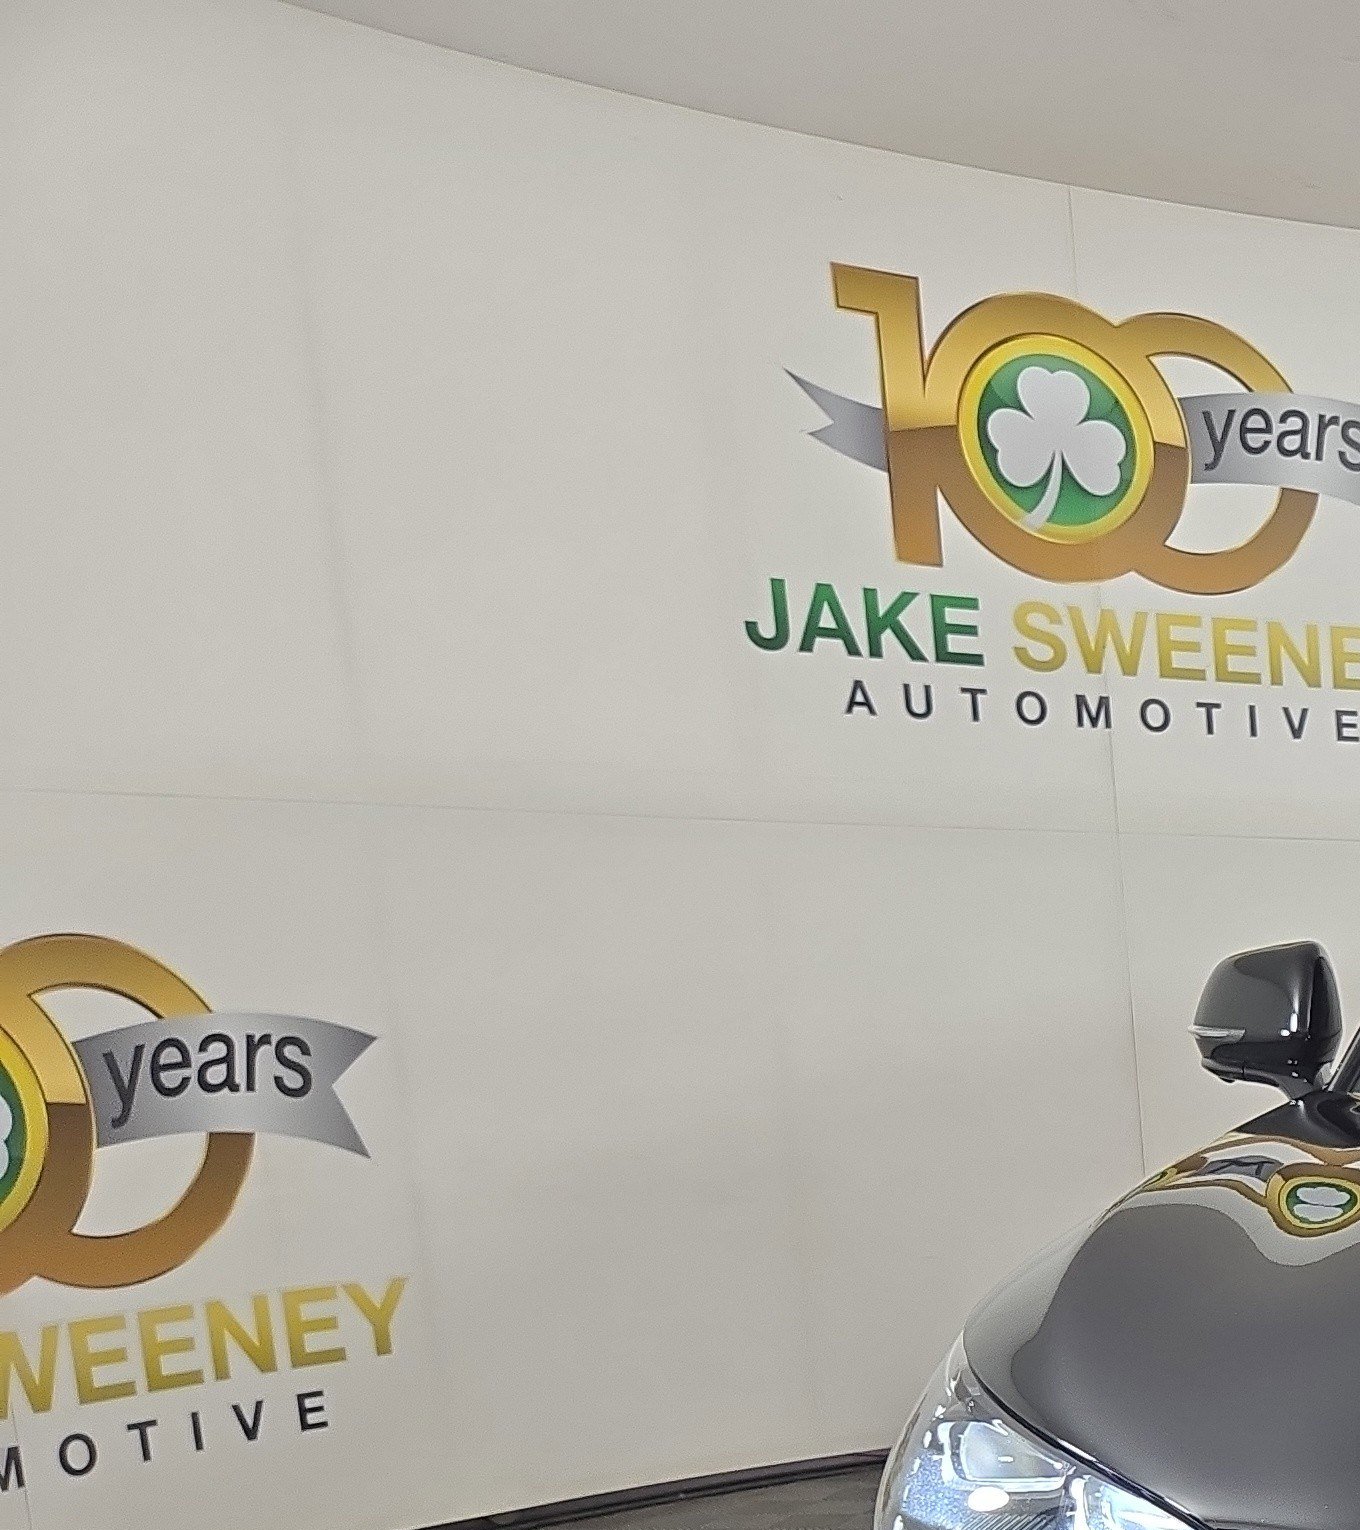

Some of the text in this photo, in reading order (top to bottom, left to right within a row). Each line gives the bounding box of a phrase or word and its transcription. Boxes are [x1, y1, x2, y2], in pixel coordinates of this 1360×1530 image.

[744, 577, 985, 667] JAKE
[845, 680, 1360, 743] AUTOMOTIVE
[103, 1032, 314, 1130] years
